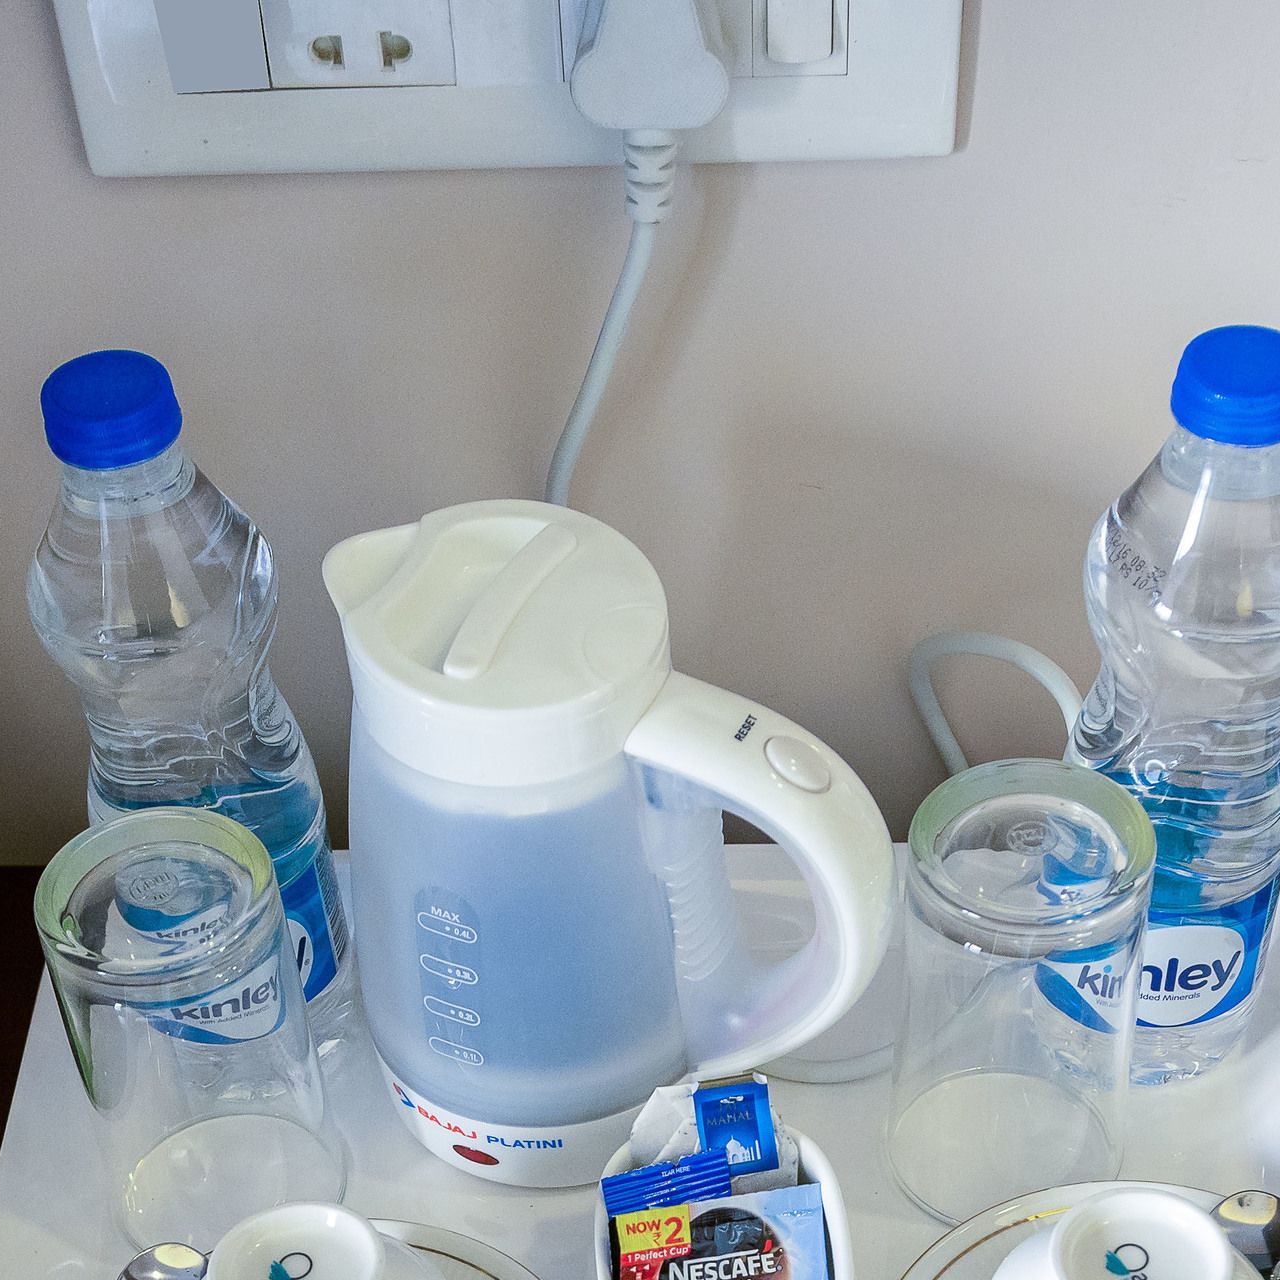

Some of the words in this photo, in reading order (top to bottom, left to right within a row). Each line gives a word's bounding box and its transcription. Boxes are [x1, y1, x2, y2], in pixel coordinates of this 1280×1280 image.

[733, 714, 758, 742] RESET
[431, 906, 461, 923] MAX
[454, 927, 472, 940] 0.4L
[170, 968, 278, 1020] kinley
[458, 1011, 475, 1023] 0.2L
[463, 1050, 479, 1063] 0.1L
[417, 1105, 478, 1140] BAJAJ
[486, 1135, 564, 1150] PLATINI
[625, 1219, 662, 1236] NOW
[634, 1250, 668, 1262] Perfect
